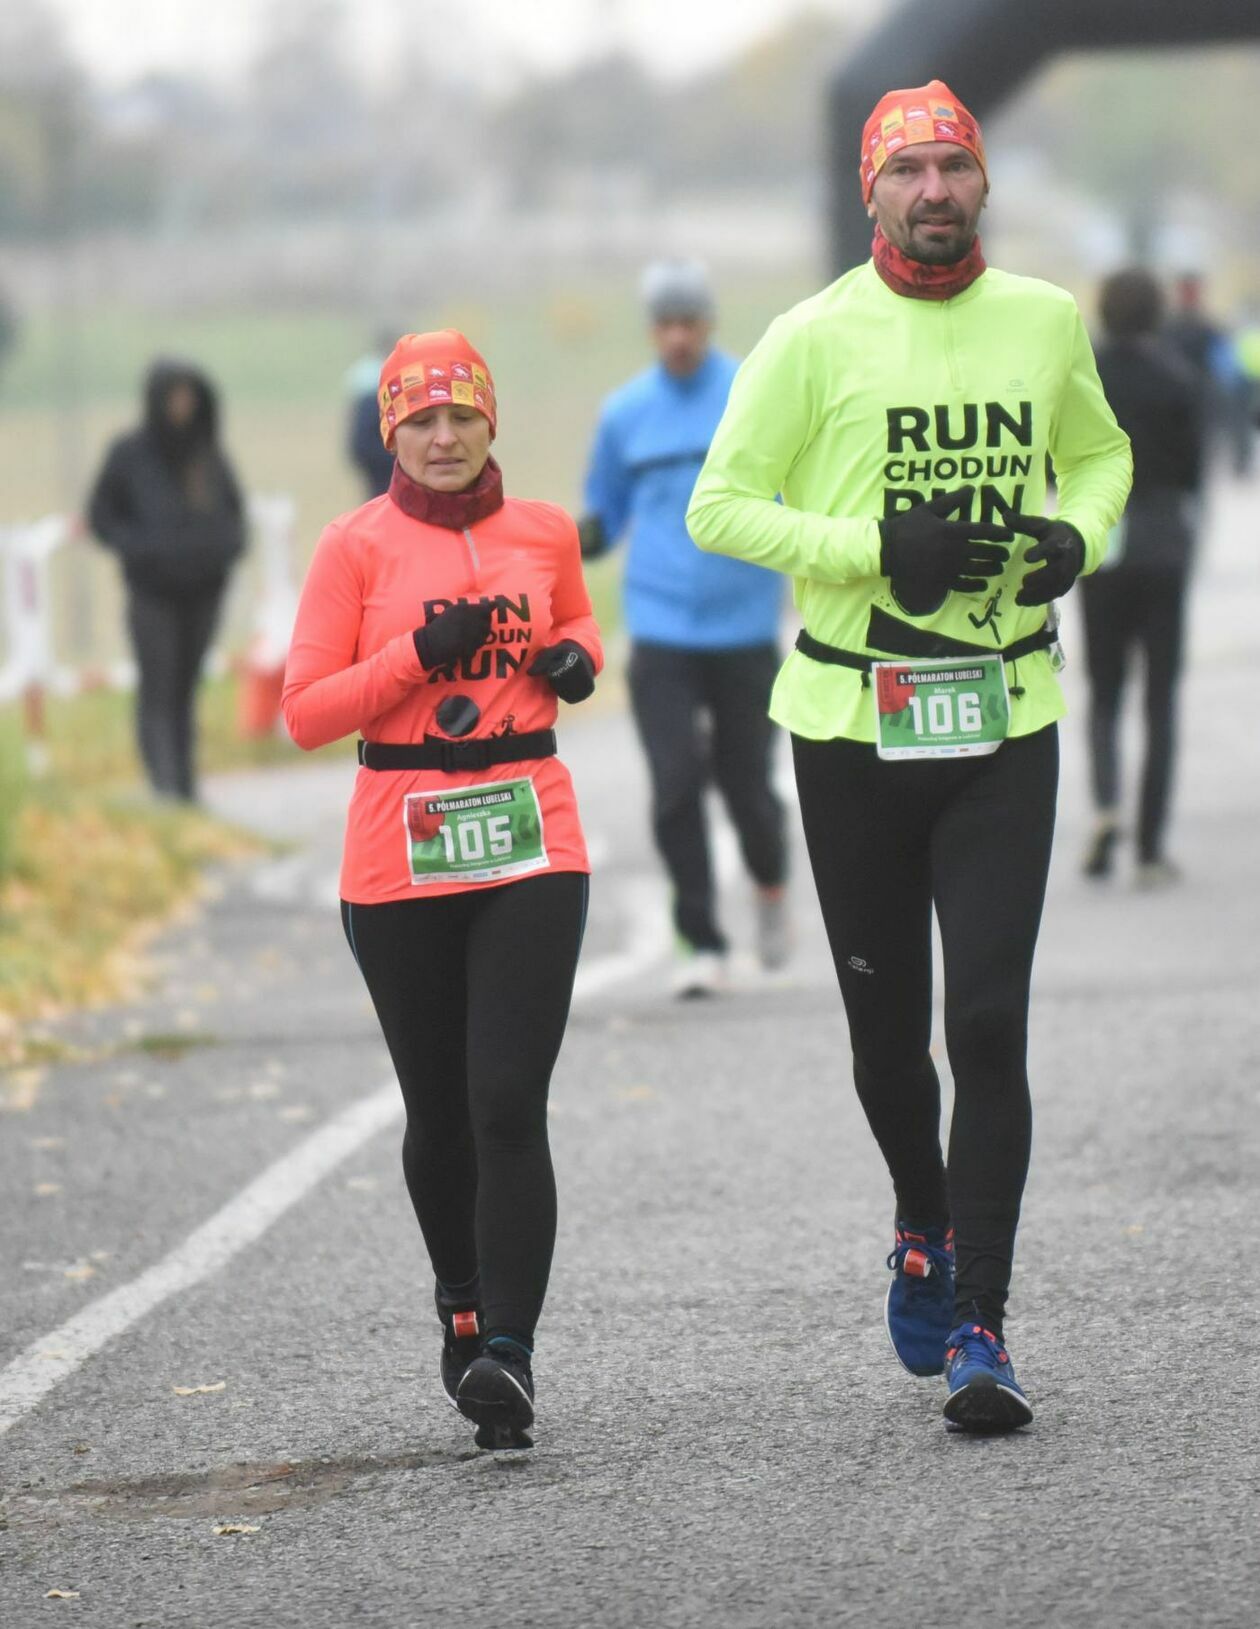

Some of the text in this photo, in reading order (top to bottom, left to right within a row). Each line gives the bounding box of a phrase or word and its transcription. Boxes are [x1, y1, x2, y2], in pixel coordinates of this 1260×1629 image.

[886, 401, 1032, 453] RUN
[884, 455, 1032, 481] CHODUN
[909, 692, 982, 735] 106
[482, 792, 512, 805] LUBELSKI
[439, 815, 513, 863] 105
